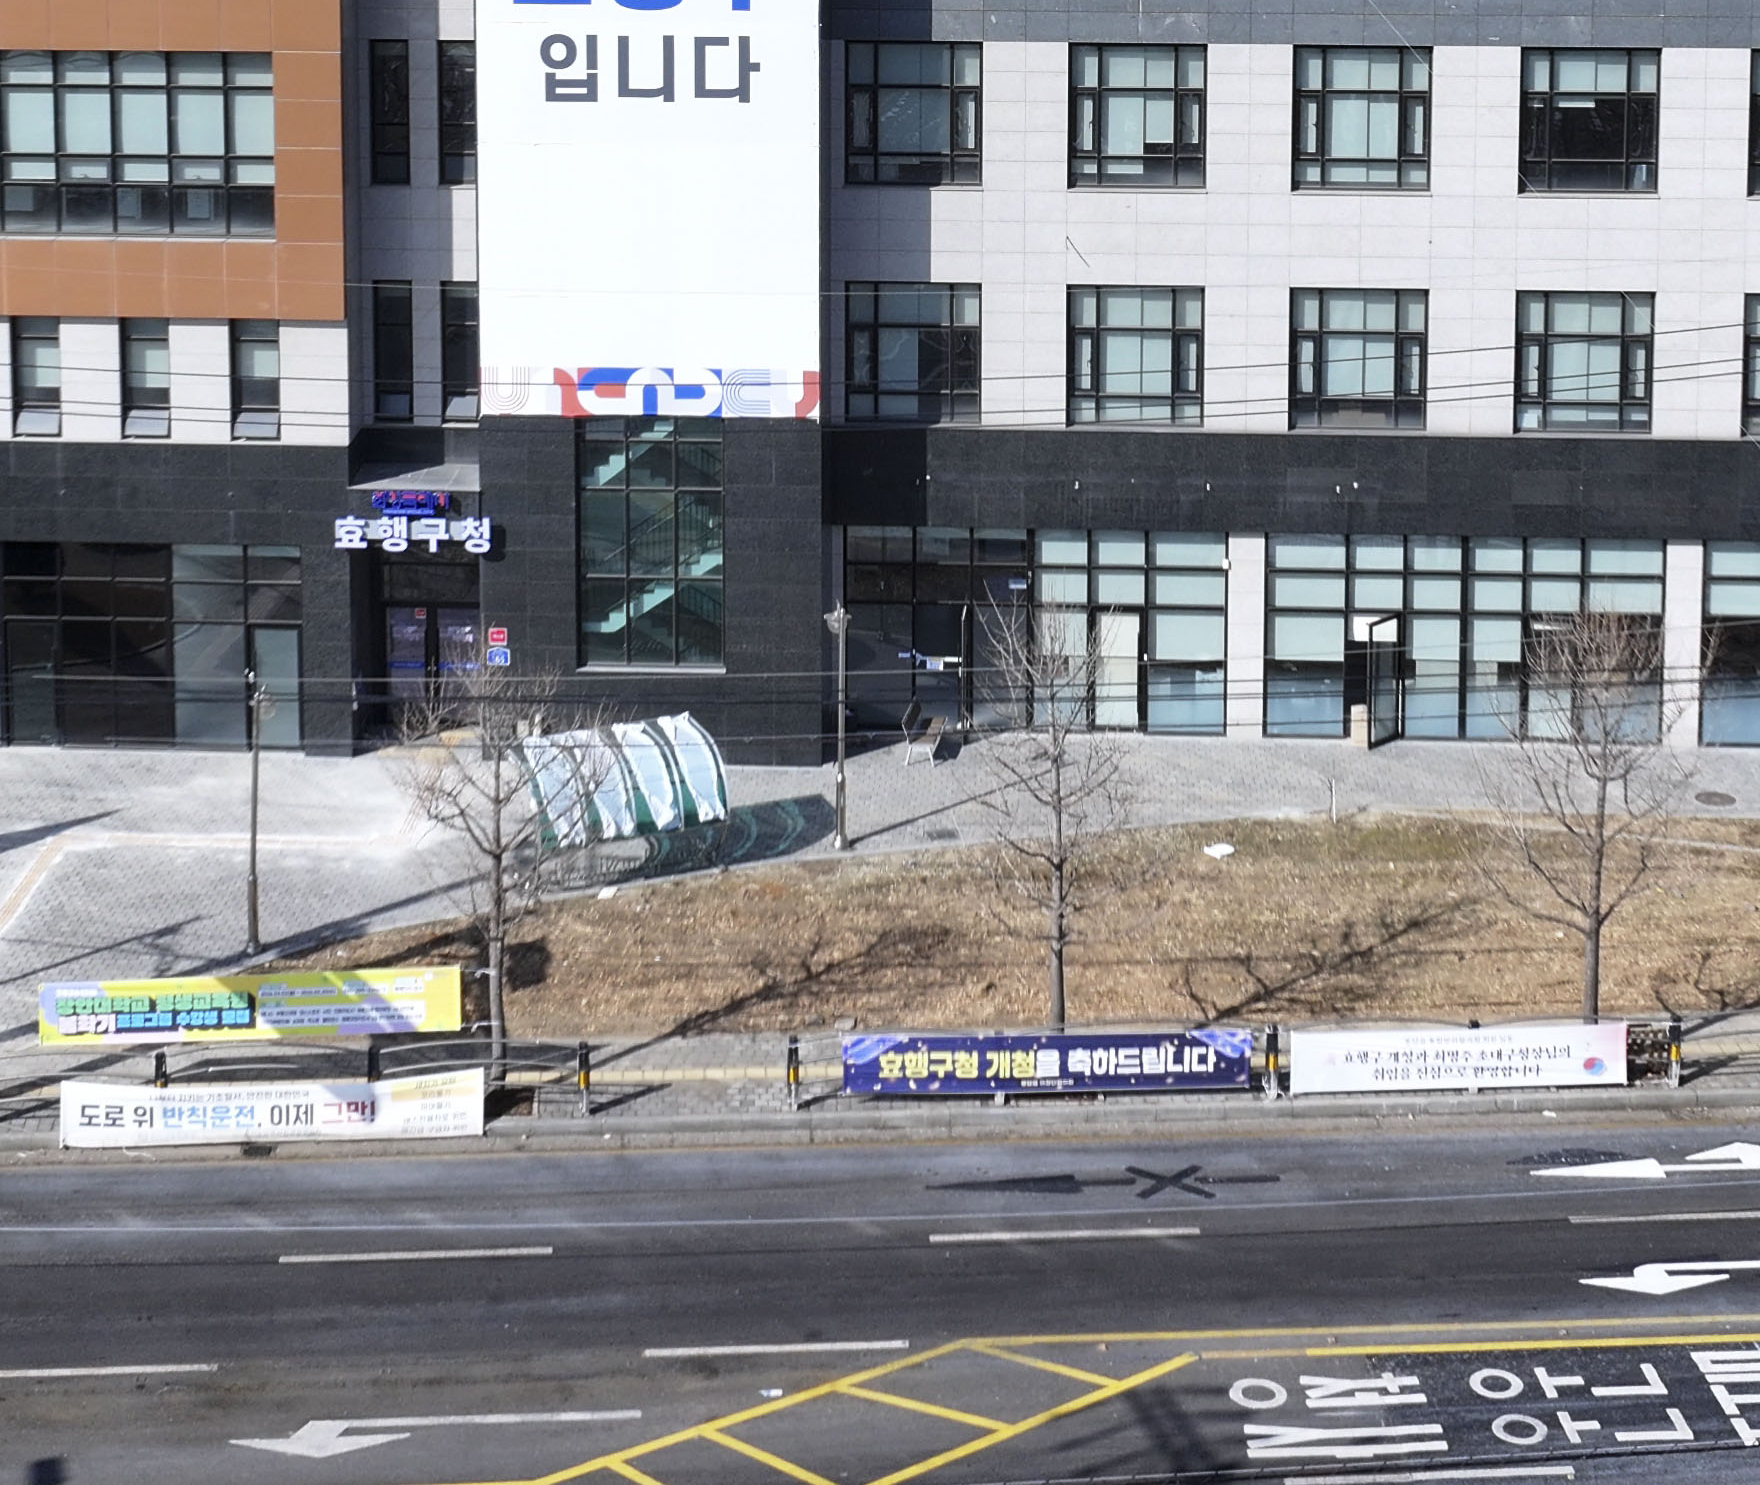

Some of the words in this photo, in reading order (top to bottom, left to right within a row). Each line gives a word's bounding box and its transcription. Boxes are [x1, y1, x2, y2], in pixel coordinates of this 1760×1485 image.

[539, 33, 761, 104] 입니다
[334, 515, 492, 554] 효행구청
[877, 1050, 980, 1080] 효행구청
[985, 1048, 1061, 1080] 개청을
[1067, 1045, 1218, 1075] 축하드립니다
[1471, 1062, 1543, 1079] 환영합니다
[79, 1104, 126, 1128] 도로
[132, 1105, 154, 1128] 위
[161, 1104, 262, 1128] 반칙운전,
[269, 1103, 315, 1126] 이제
[321, 1100, 376, 1124] 그만!
